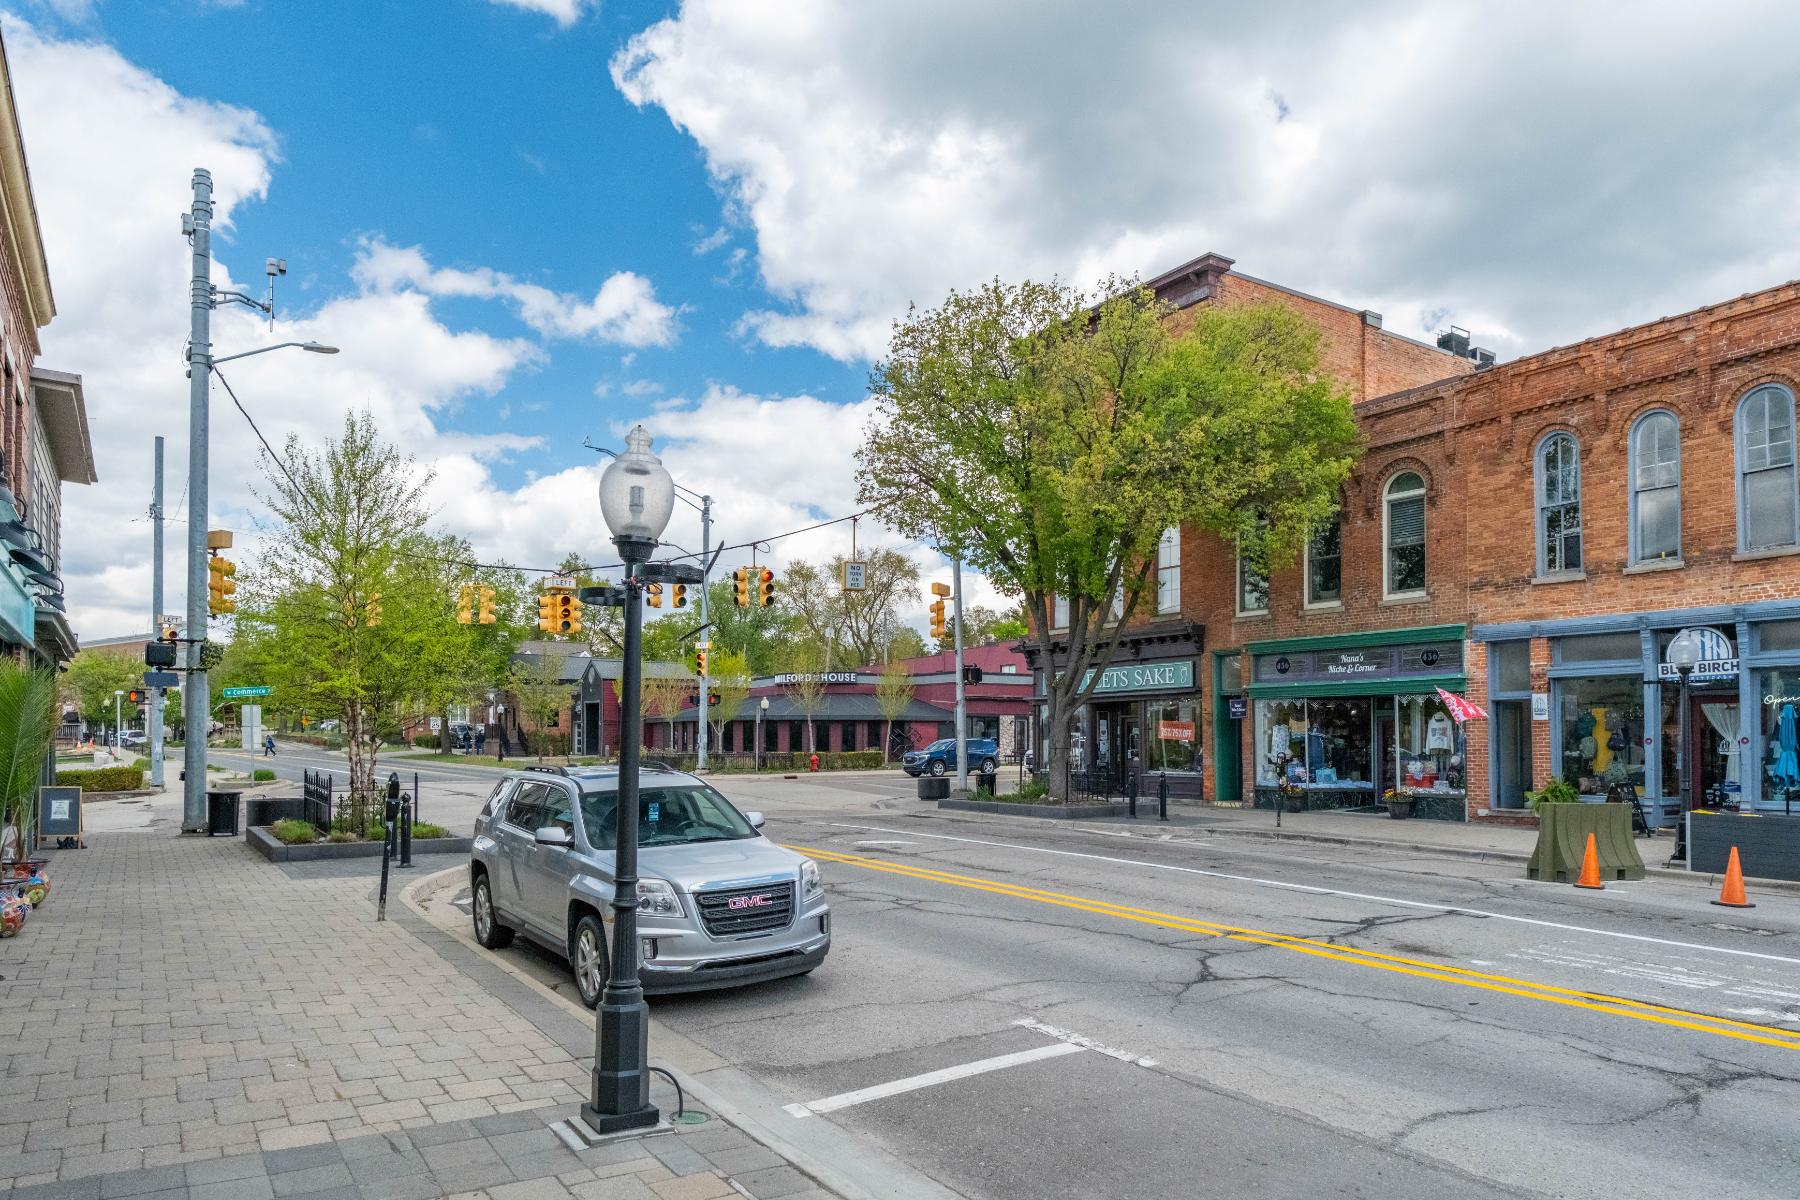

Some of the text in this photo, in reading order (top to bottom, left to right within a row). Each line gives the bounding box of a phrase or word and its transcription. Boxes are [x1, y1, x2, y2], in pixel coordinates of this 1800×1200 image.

[555, 579, 572, 587] LEFT
[1340, 652, 1364, 663] Nana's
[1328, 663, 1376, 674] Niche & Corner
[1661, 661, 1740, 676] BLE BIRCH
[774, 672, 856, 683] MILFORD HOUSE
[1134, 668, 1174, 686] SAKE
[233, 688, 266, 696] Commerce
[1764, 694, 1800, 709] Open
[729, 894, 772, 909] GMC
